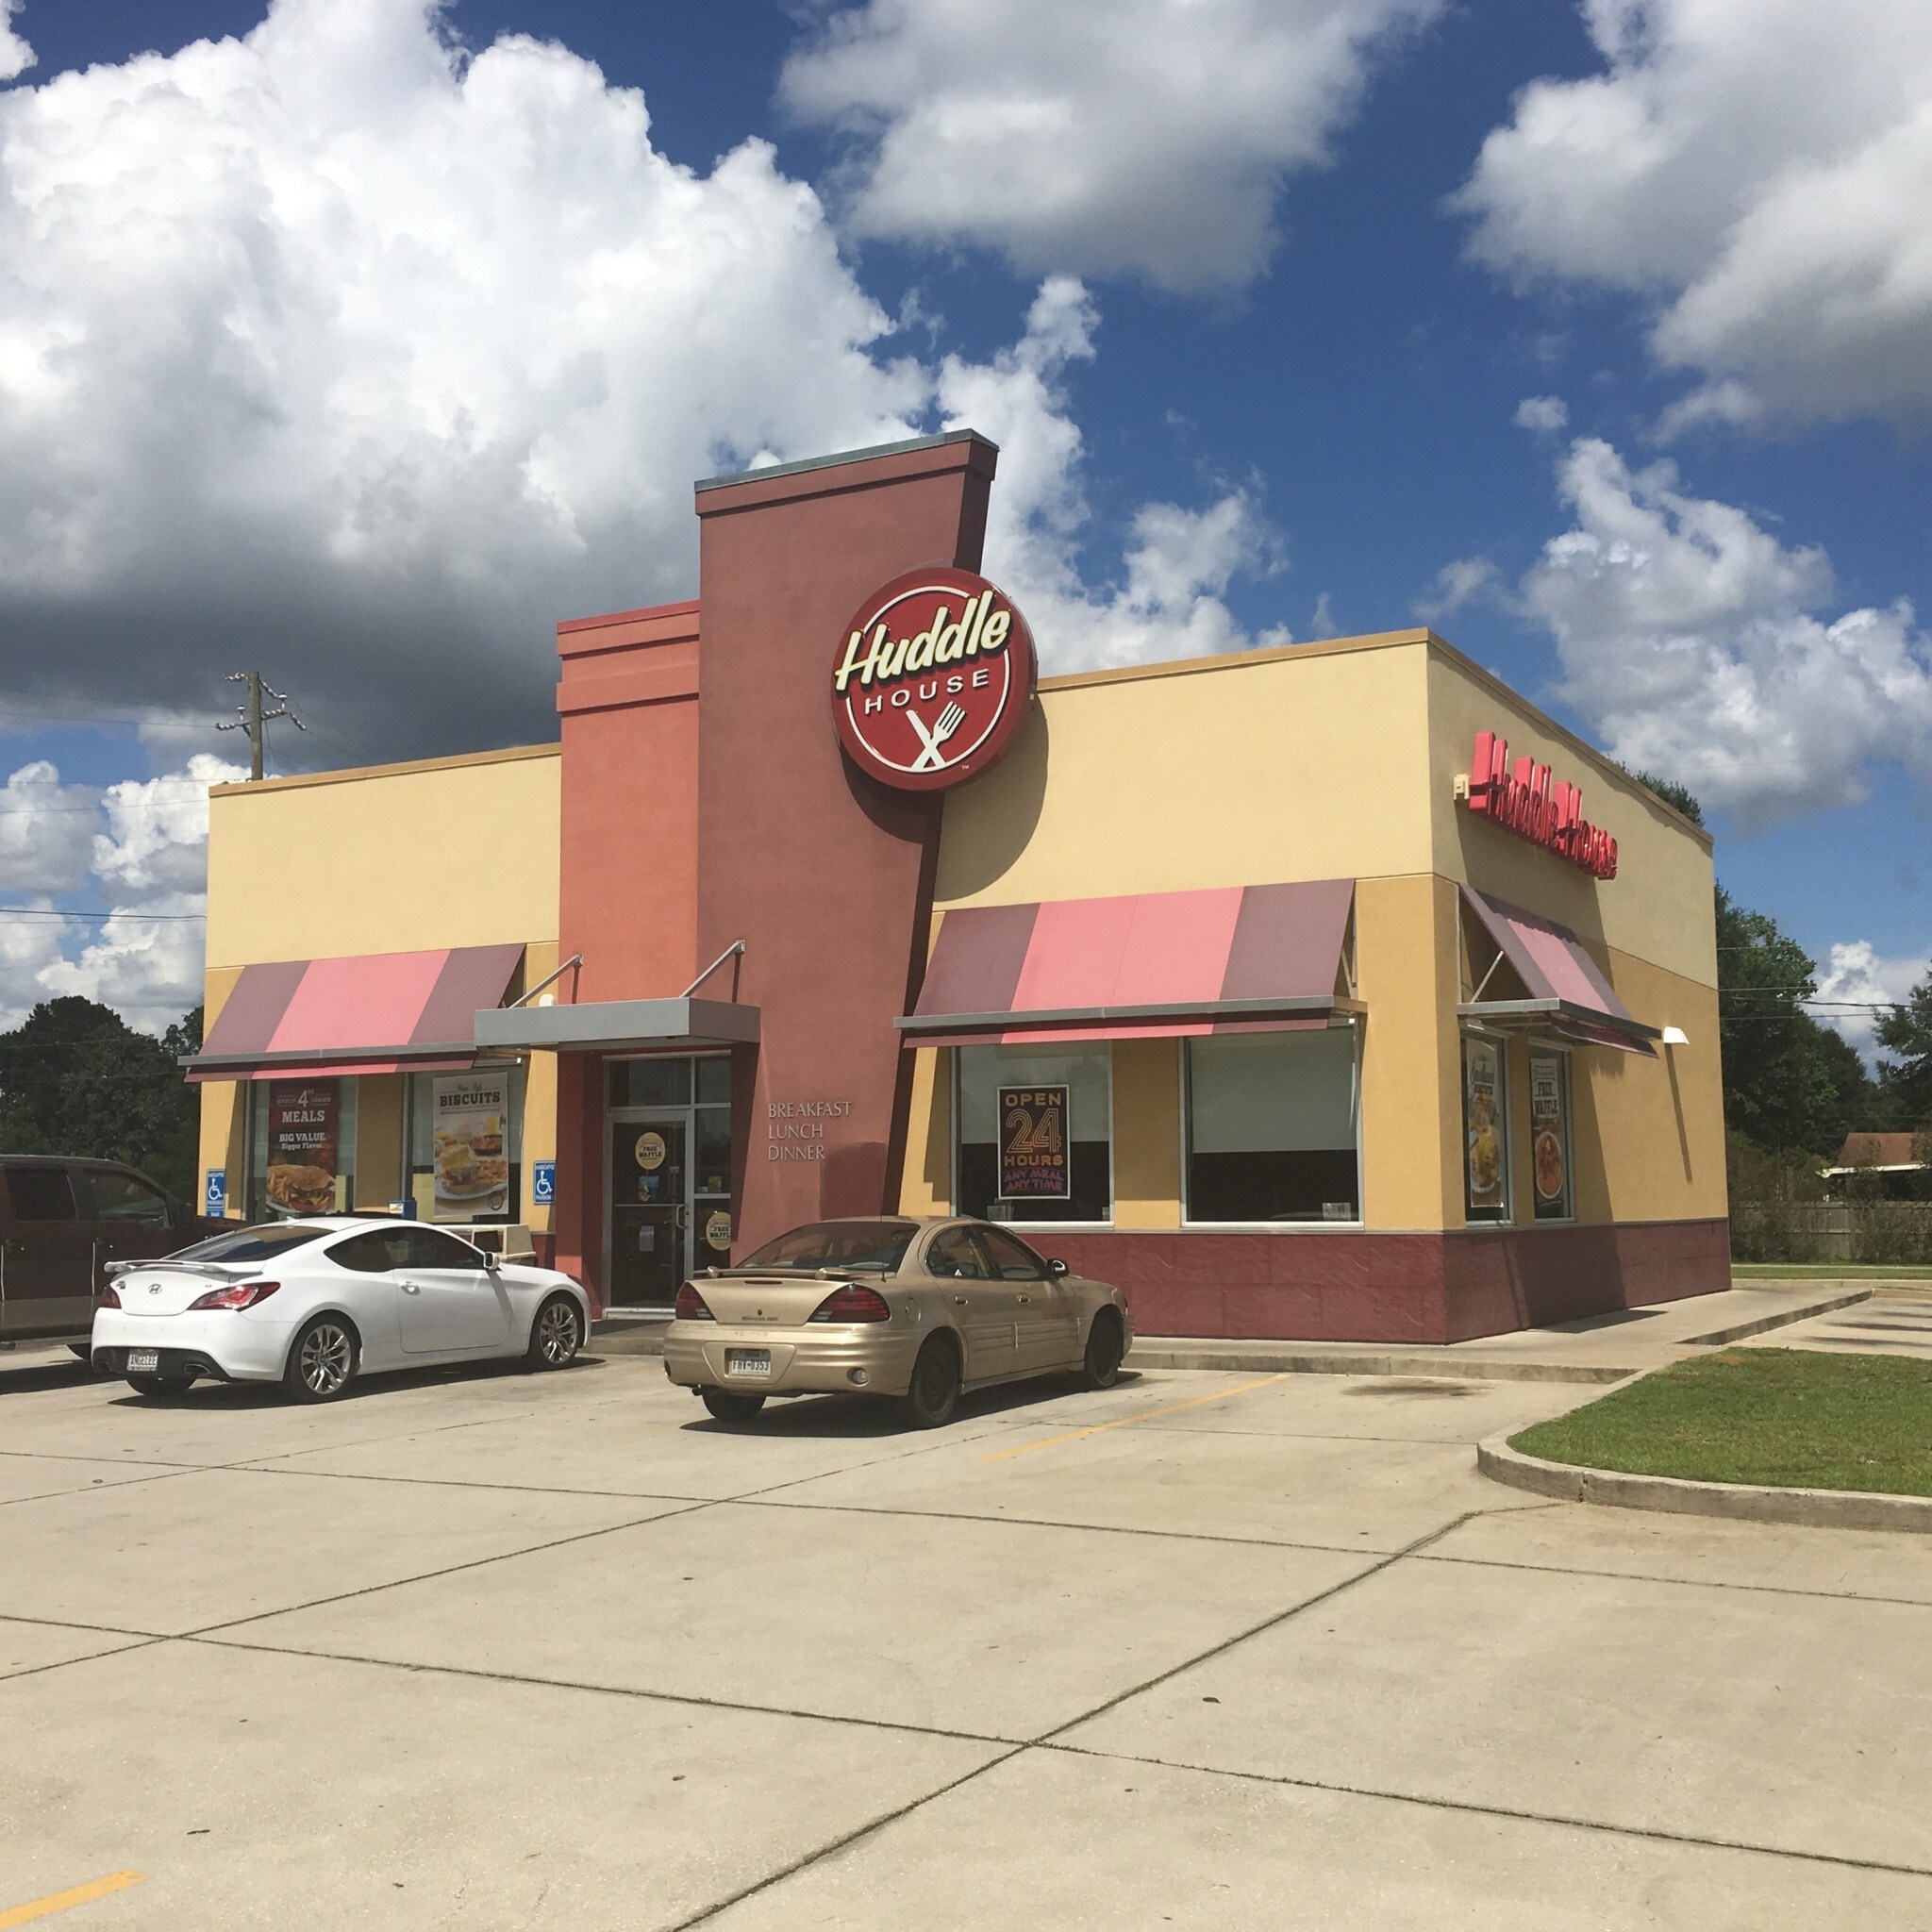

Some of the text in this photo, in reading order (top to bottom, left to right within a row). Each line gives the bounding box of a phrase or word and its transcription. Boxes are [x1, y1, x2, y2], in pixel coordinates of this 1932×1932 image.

[834, 590, 1011, 691] Huddle
[864, 668, 990, 715] HOUSE
[440, 1091, 501, 1107] BISCUITS
[1005, 1092, 1061, 1107] OPEN
[282, 1109, 325, 1124] MEALS
[768, 1101, 852, 1119] BREAKFAST
[279, 1133, 294, 1142] BIG
[768, 1124, 824, 1141] LUNCH
[1006, 1108, 1062, 1153] 24
[281, 1142, 301, 1151] Bigger
[768, 1144, 825, 1161] DINNER
[1004, 1155, 1063, 1166] HOURS
[1004, 1169, 1063, 1182] ANY MEAL
[1007, 1179, 1062, 1191] ANY TIME
